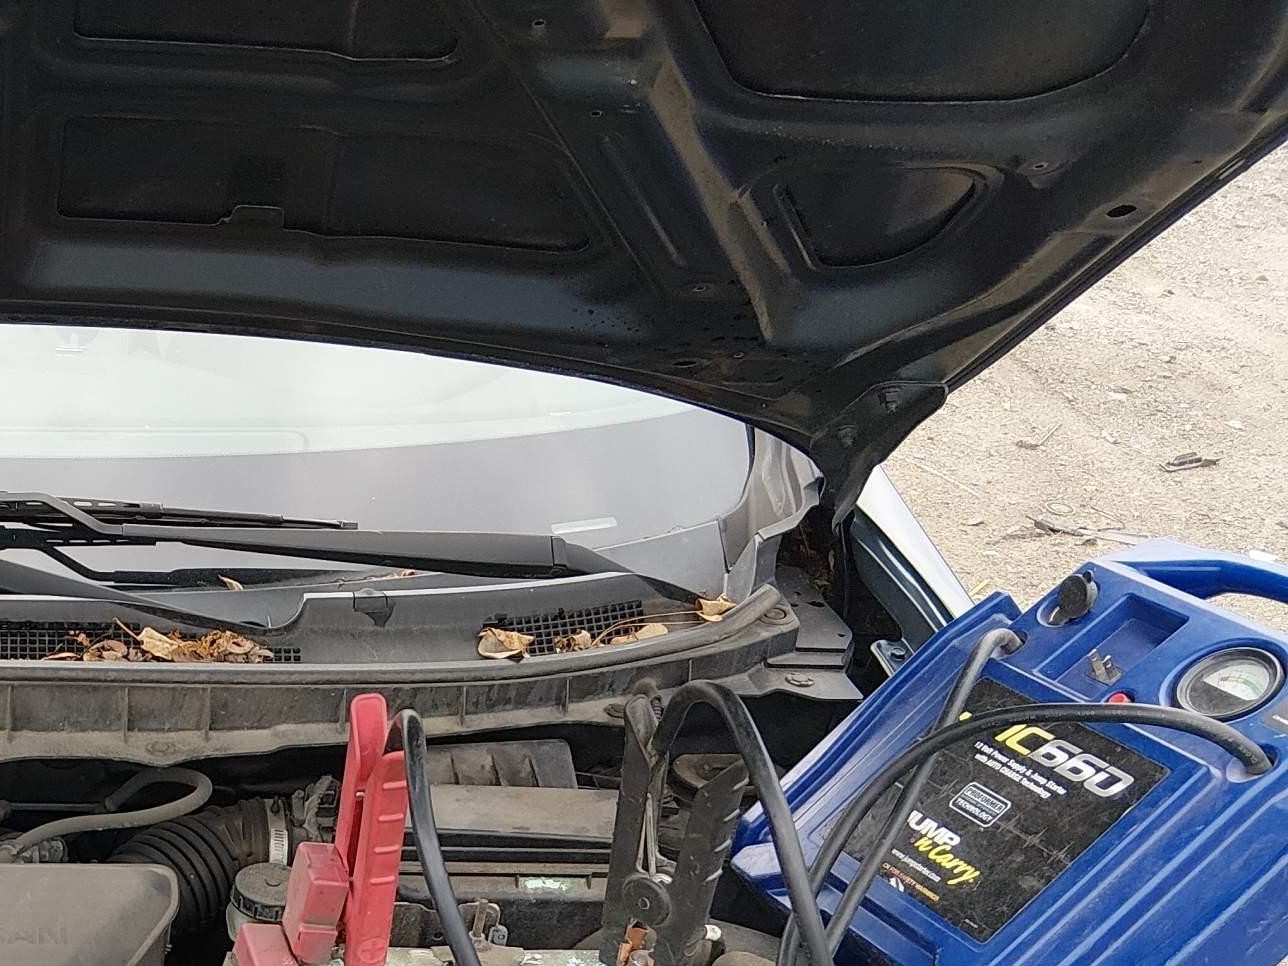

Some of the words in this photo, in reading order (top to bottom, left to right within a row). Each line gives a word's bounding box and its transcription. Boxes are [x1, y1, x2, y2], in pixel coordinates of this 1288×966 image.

[1007, 759, 1027, 774] Supply
[955, 798, 994, 822] TECHNOLOGY
[965, 787, 1004, 813] PROFORMER
[907, 810, 961, 846] UMP
